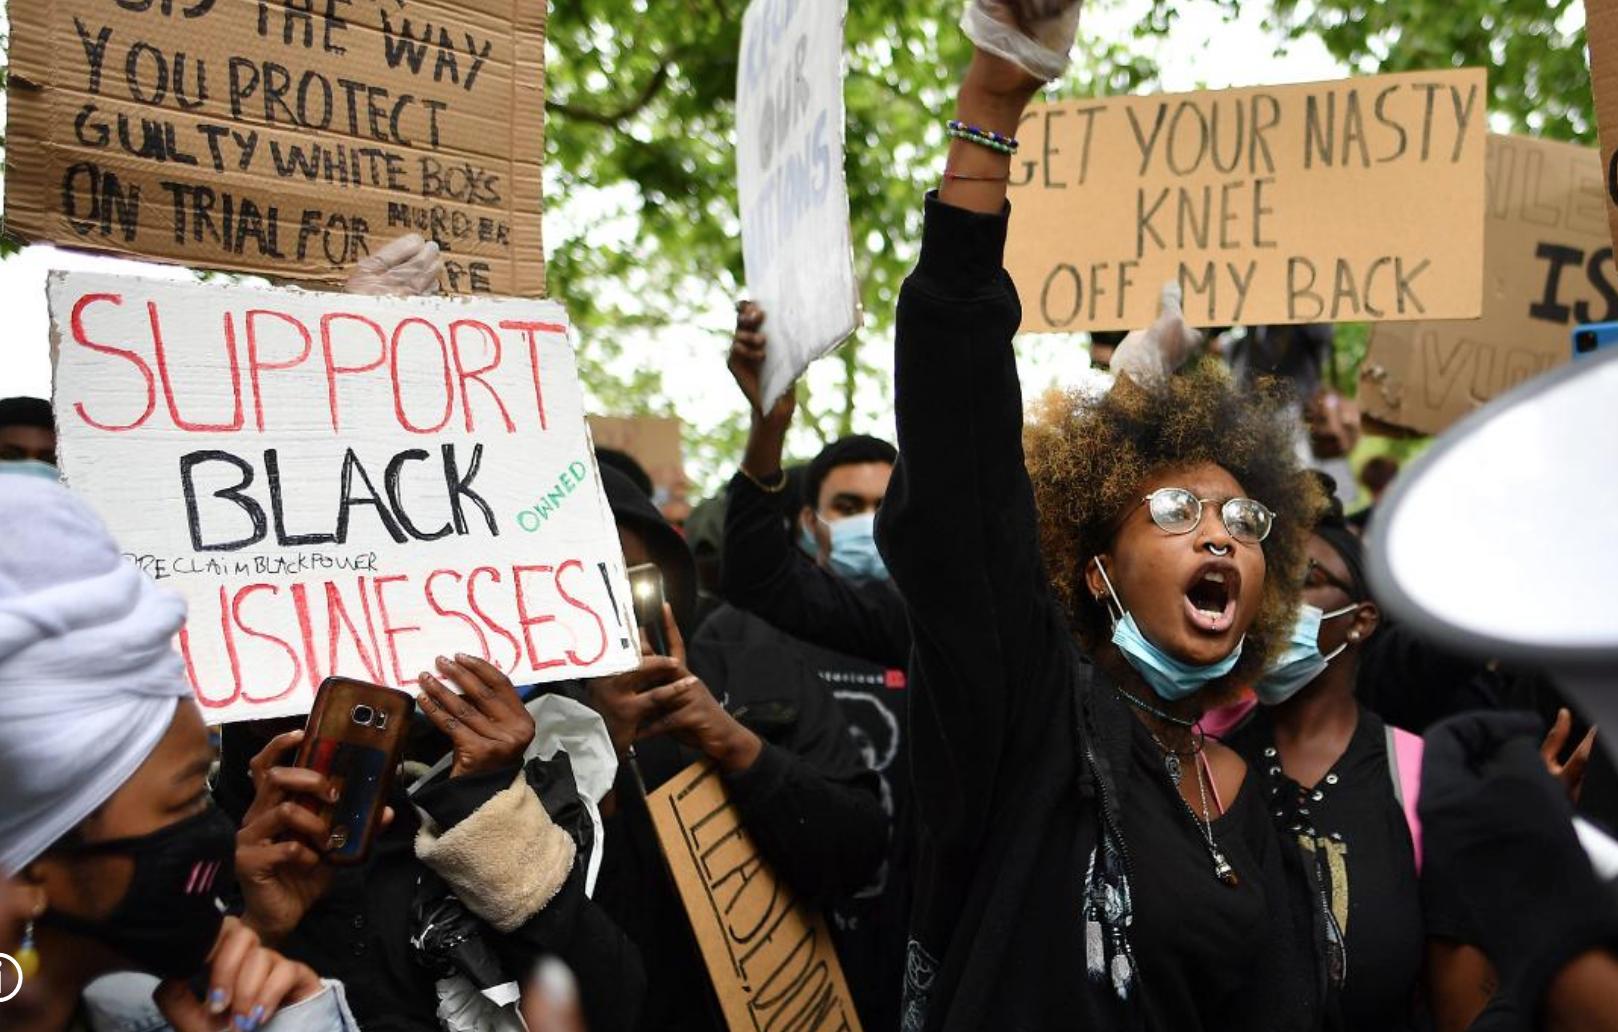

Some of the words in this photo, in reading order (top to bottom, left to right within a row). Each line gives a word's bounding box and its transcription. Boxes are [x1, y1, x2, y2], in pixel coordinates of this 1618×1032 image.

[73, 16, 208, 109] YOU
[229, 56, 447, 148] PROTECT
[380, 8, 492, 91] WAY
[74, 103, 259, 173] GUILTY
[269, 140, 411, 193] WHITE
[416, 155, 502, 205] BOYS
[1125, 94, 1281, 178] YOUR
[1303, 83, 1478, 171] NASTY
[62, 161, 141, 243] ON
[160, 181, 285, 260] TRIAL
[297, 210, 371, 270] FOR
[387, 200, 511, 246] MURDER
[1136, 178, 1278, 259] KNEE
[1040, 260, 1140, 328] OFF
[1177, 259, 1257, 322] MY
[1285, 256, 1432, 321] BACK
[1528, 241, 1618, 325] IS
[70, 292, 567, 434] SUPPORT
[179, 443, 500, 552] BLACK
[516, 460, 587, 533] OWNED
[178, 559, 631, 710] USINESSES!
